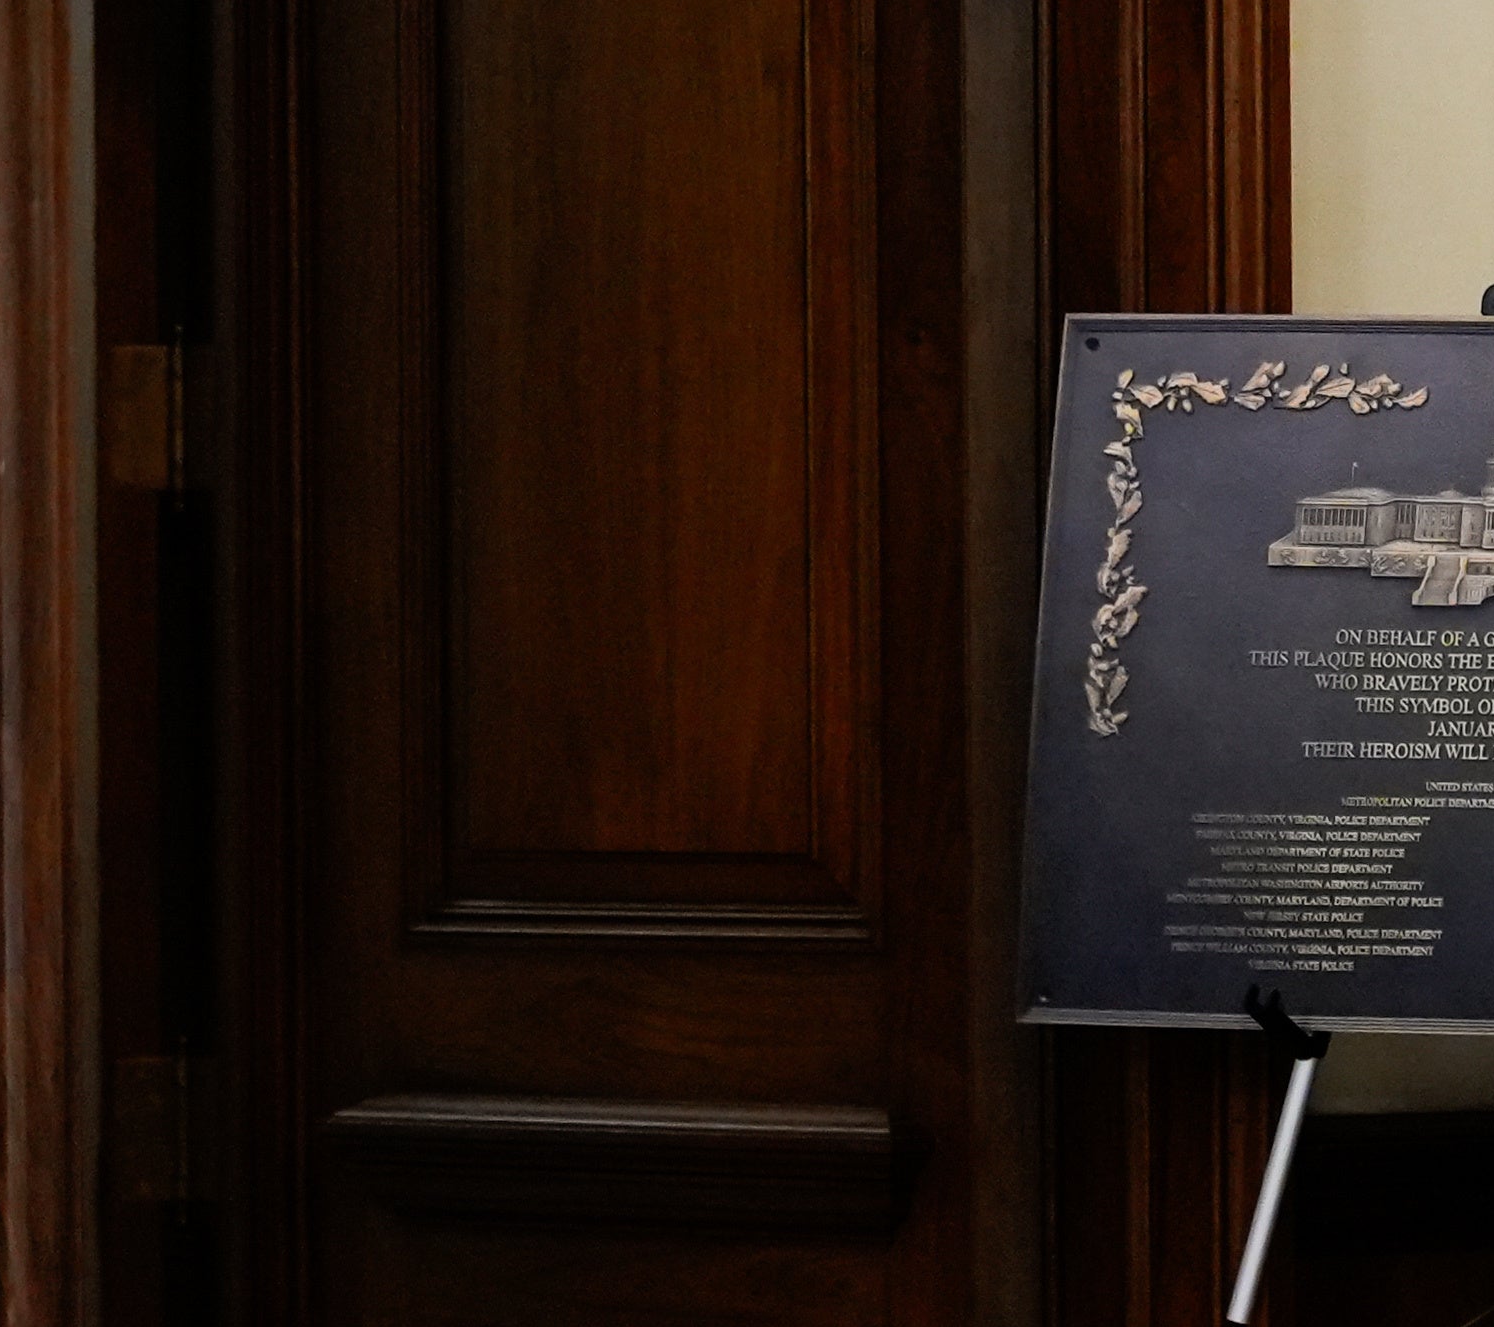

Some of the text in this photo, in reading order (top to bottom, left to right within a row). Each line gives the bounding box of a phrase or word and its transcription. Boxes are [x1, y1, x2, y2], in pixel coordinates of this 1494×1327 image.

[1336, 629, 1363, 646] ON
[1366, 630, 1437, 646] BEHALF
[1441, 630, 1465, 647] OF
[1467, 632, 1480, 647] A
[1249, 650, 1289, 667] THIS
[1294, 651, 1365, 671] PLAQUE
[1370, 652, 1443, 669] HONORS
[1448, 653, 1482, 670] THE
[1315, 674, 1358, 690] WHO
[1362, 675, 1444, 691] BRAVELY
[1355, 697, 1394, 713] THIS
[1399, 697, 1474, 714] SYMBOL
[1301, 742, 1355, 758] THEIR
[1359, 742, 1442, 759] HEROISM
[1445, 744, 1488, 760] WILL
[1426, 782, 1460, 792] UNITED
[1462, 782, 1493, 793] STATES
[1414, 797, 1446, 808] POLICE
[1334, 815, 1367, 825] POLICE
[1369, 816, 1431, 826] DEPARTMENT
[1326, 831, 1358, 841] POLICE
[1360, 832, 1421, 842] DEPARTMENT
[1328, 848, 1342, 857] OF
[1343, 848, 1370, 858] STATE
[1372, 849, 1405, 858] POLICE
[1297, 863, 1329, 873] POLICE
[1331, 863, 1393, 874] DEPARTMENT
[1334, 896, 1395, 907] DEPARTMENT
[1411, 897, 1444, 908] POLICE
[1302, 912, 1330, 922] STATE
[1331, 912, 1364, 922] POLICE
